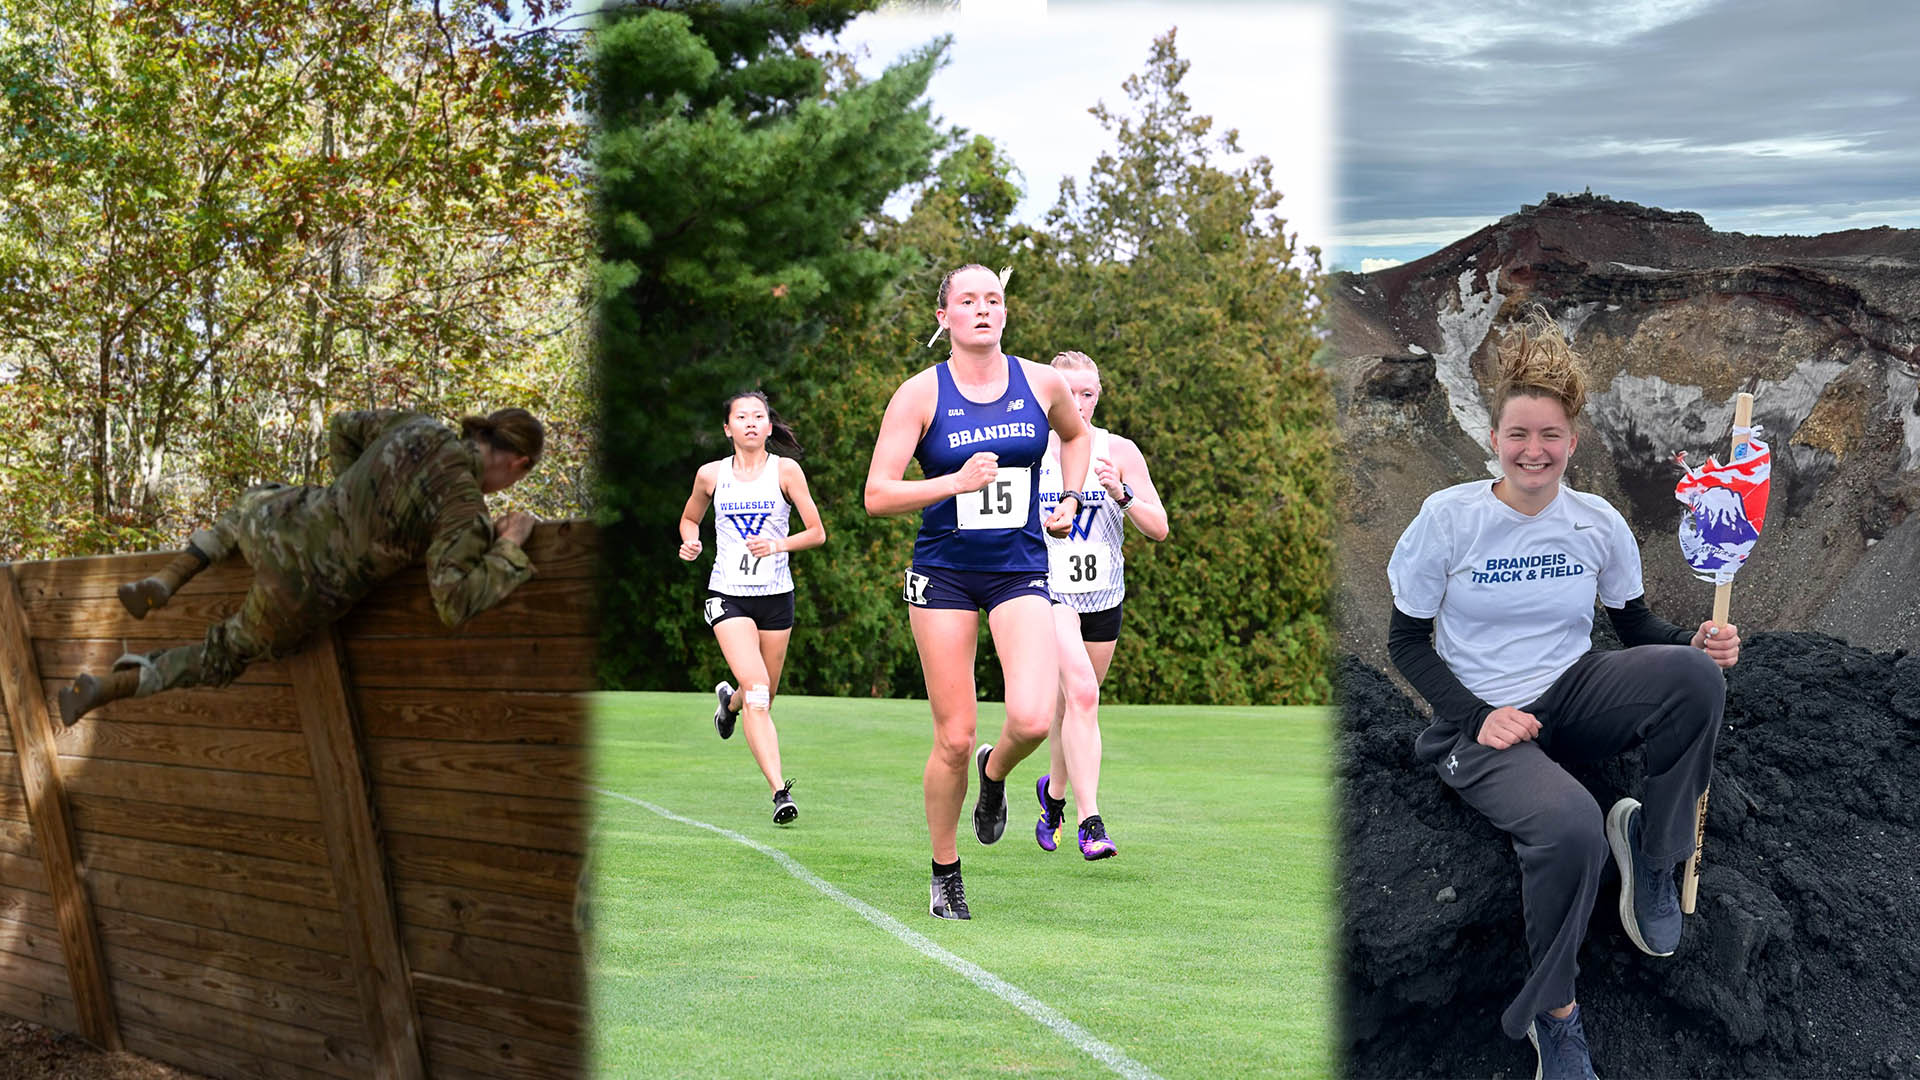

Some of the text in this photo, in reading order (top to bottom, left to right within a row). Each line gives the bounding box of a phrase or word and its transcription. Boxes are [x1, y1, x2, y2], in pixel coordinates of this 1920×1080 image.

[948, 423, 1035, 448] BRANDEIS
[720, 500, 776, 511] WELLESLEY
[979, 481, 1012, 515] 15
[739, 553, 762, 575] 47
[1069, 554, 1097, 582] 38
[1486, 553, 1566, 571] BRANDEIS
[1472, 564, 1584, 584] TRACK & FIELD
